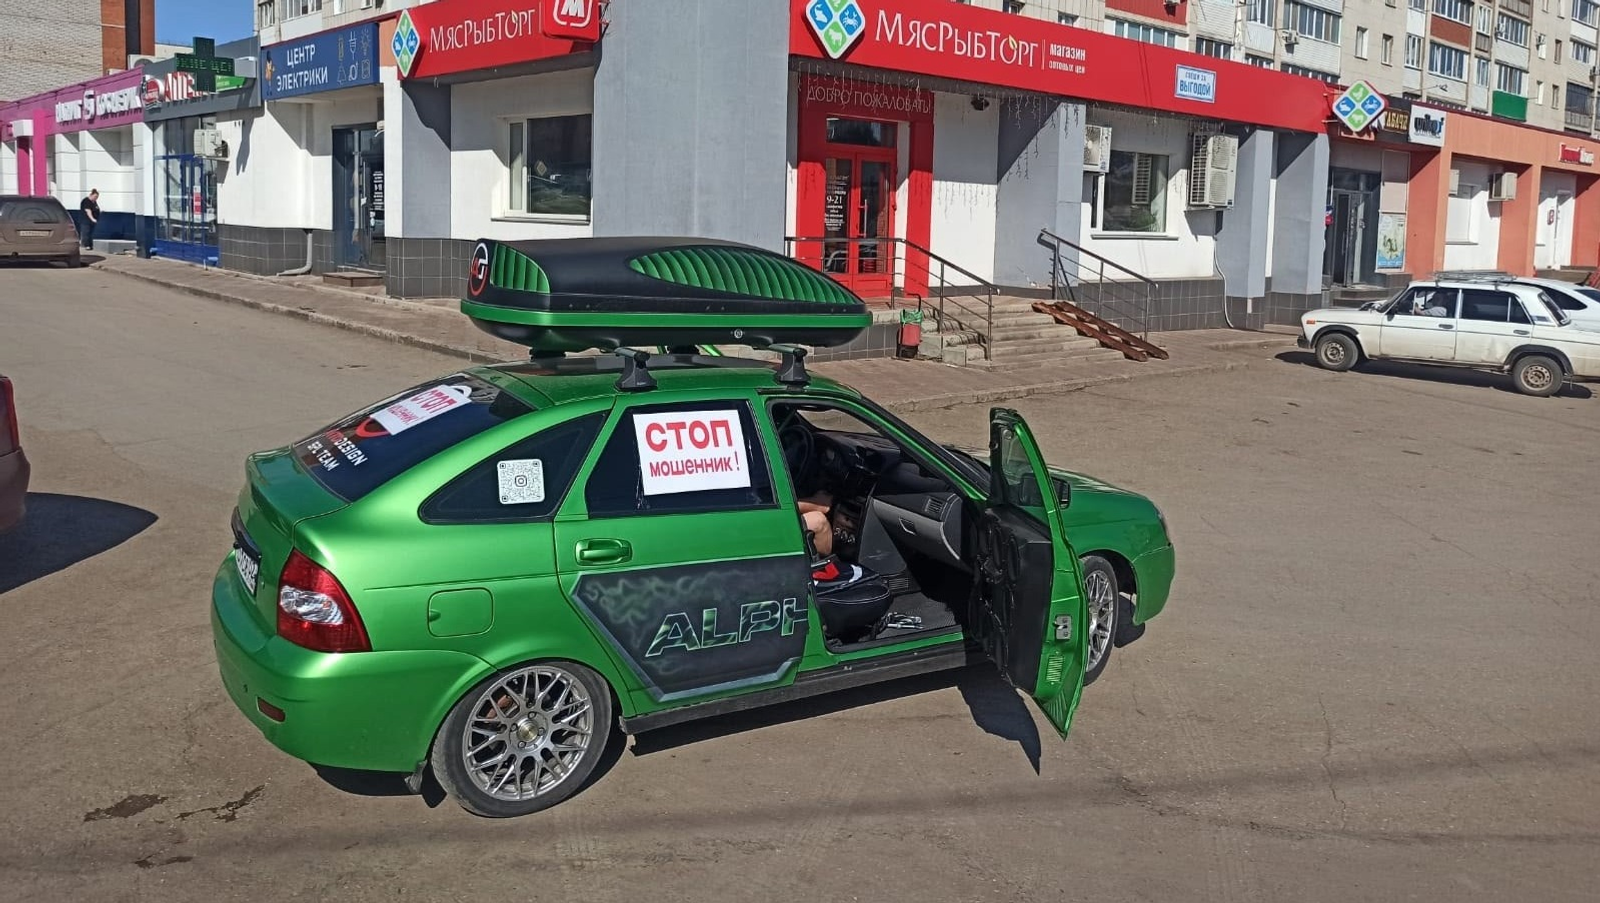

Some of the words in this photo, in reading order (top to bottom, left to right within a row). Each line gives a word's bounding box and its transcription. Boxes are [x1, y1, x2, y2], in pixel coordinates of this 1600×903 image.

[286, 44, 316, 68] ЦЕНТР
[276, 66, 328, 92] ЭЛЕКТРИКИ
[1180, 79, 1211, 97] ВЫГОДОЙ
[808, 85, 851, 105] ДОБРО
[645, 420, 732, 452] СТОП
[316, 449, 340, 471] TEAM
